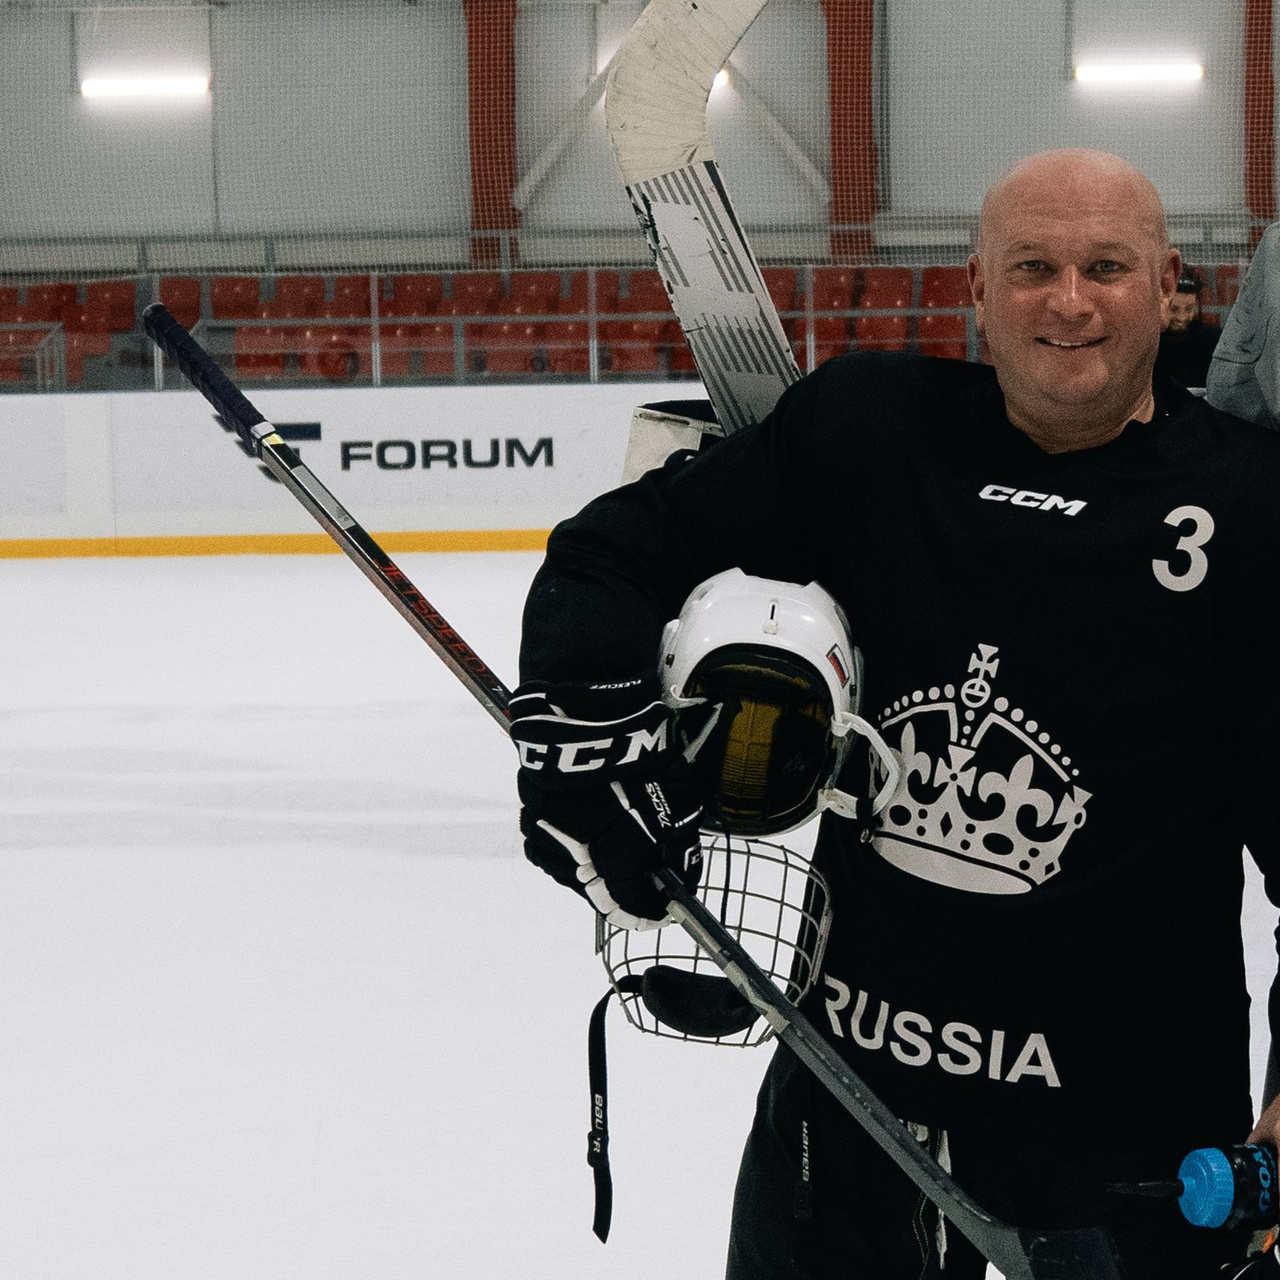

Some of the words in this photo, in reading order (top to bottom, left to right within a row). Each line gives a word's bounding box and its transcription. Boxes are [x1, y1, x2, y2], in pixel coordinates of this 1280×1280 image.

[339, 437, 555, 471] FORUM
[978, 483, 1088, 517] CCM
[1151, 504, 1216, 593] 3
[513, 717, 670, 773] CCM
[644, 782, 672, 829] TACKS
[823, 972, 1062, 1089] RUSSIA
[592, 1093, 604, 1154] BAUR
